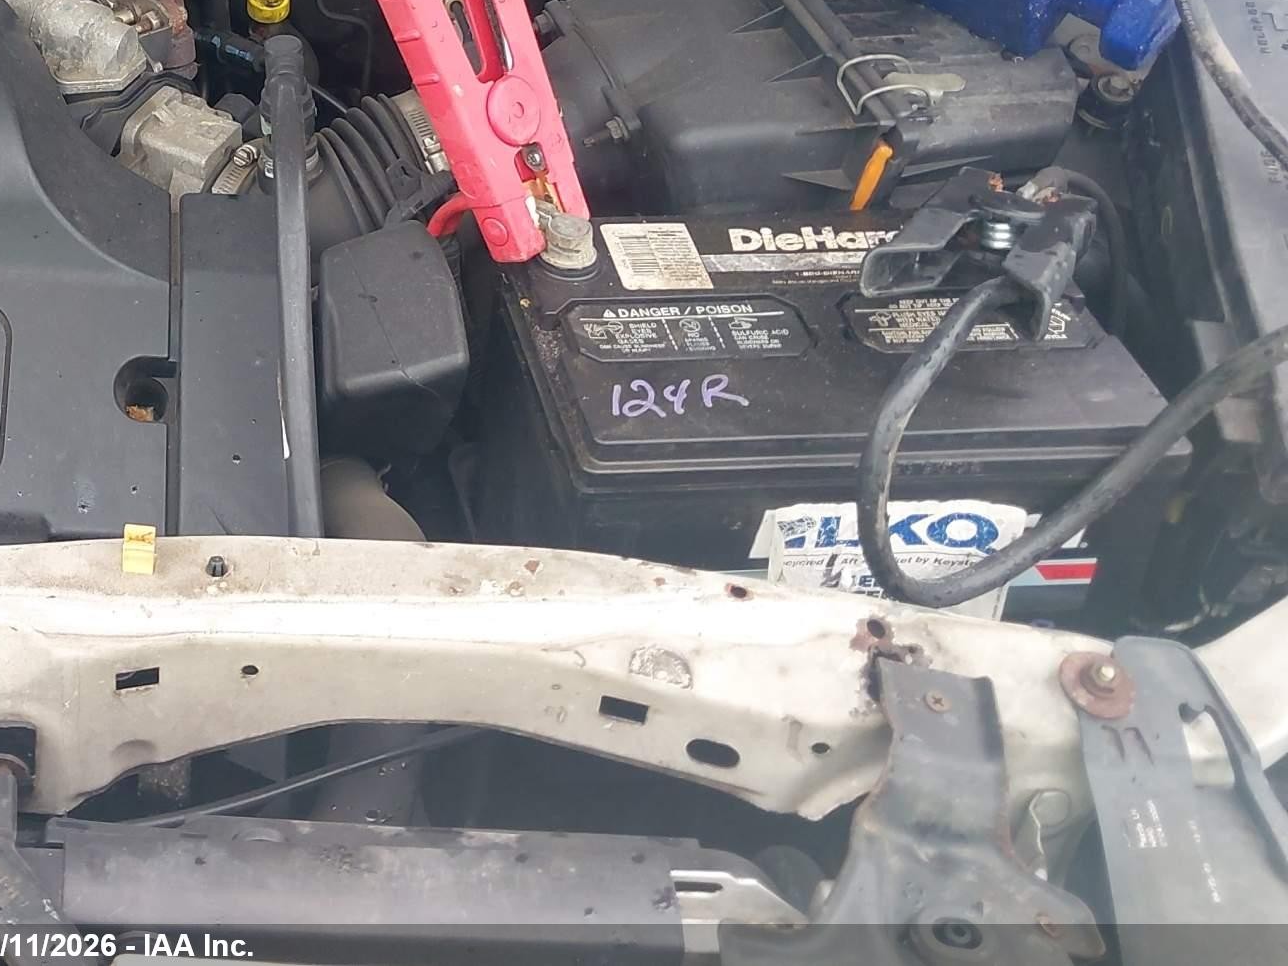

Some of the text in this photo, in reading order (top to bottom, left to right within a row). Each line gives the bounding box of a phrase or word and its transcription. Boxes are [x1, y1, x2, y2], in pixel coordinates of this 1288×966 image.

[728, 225, 902, 253] DieHar
[617, 306, 681, 318] DANGER
[695, 304, 754, 315] POISON
[915, 555, 930, 565] by
